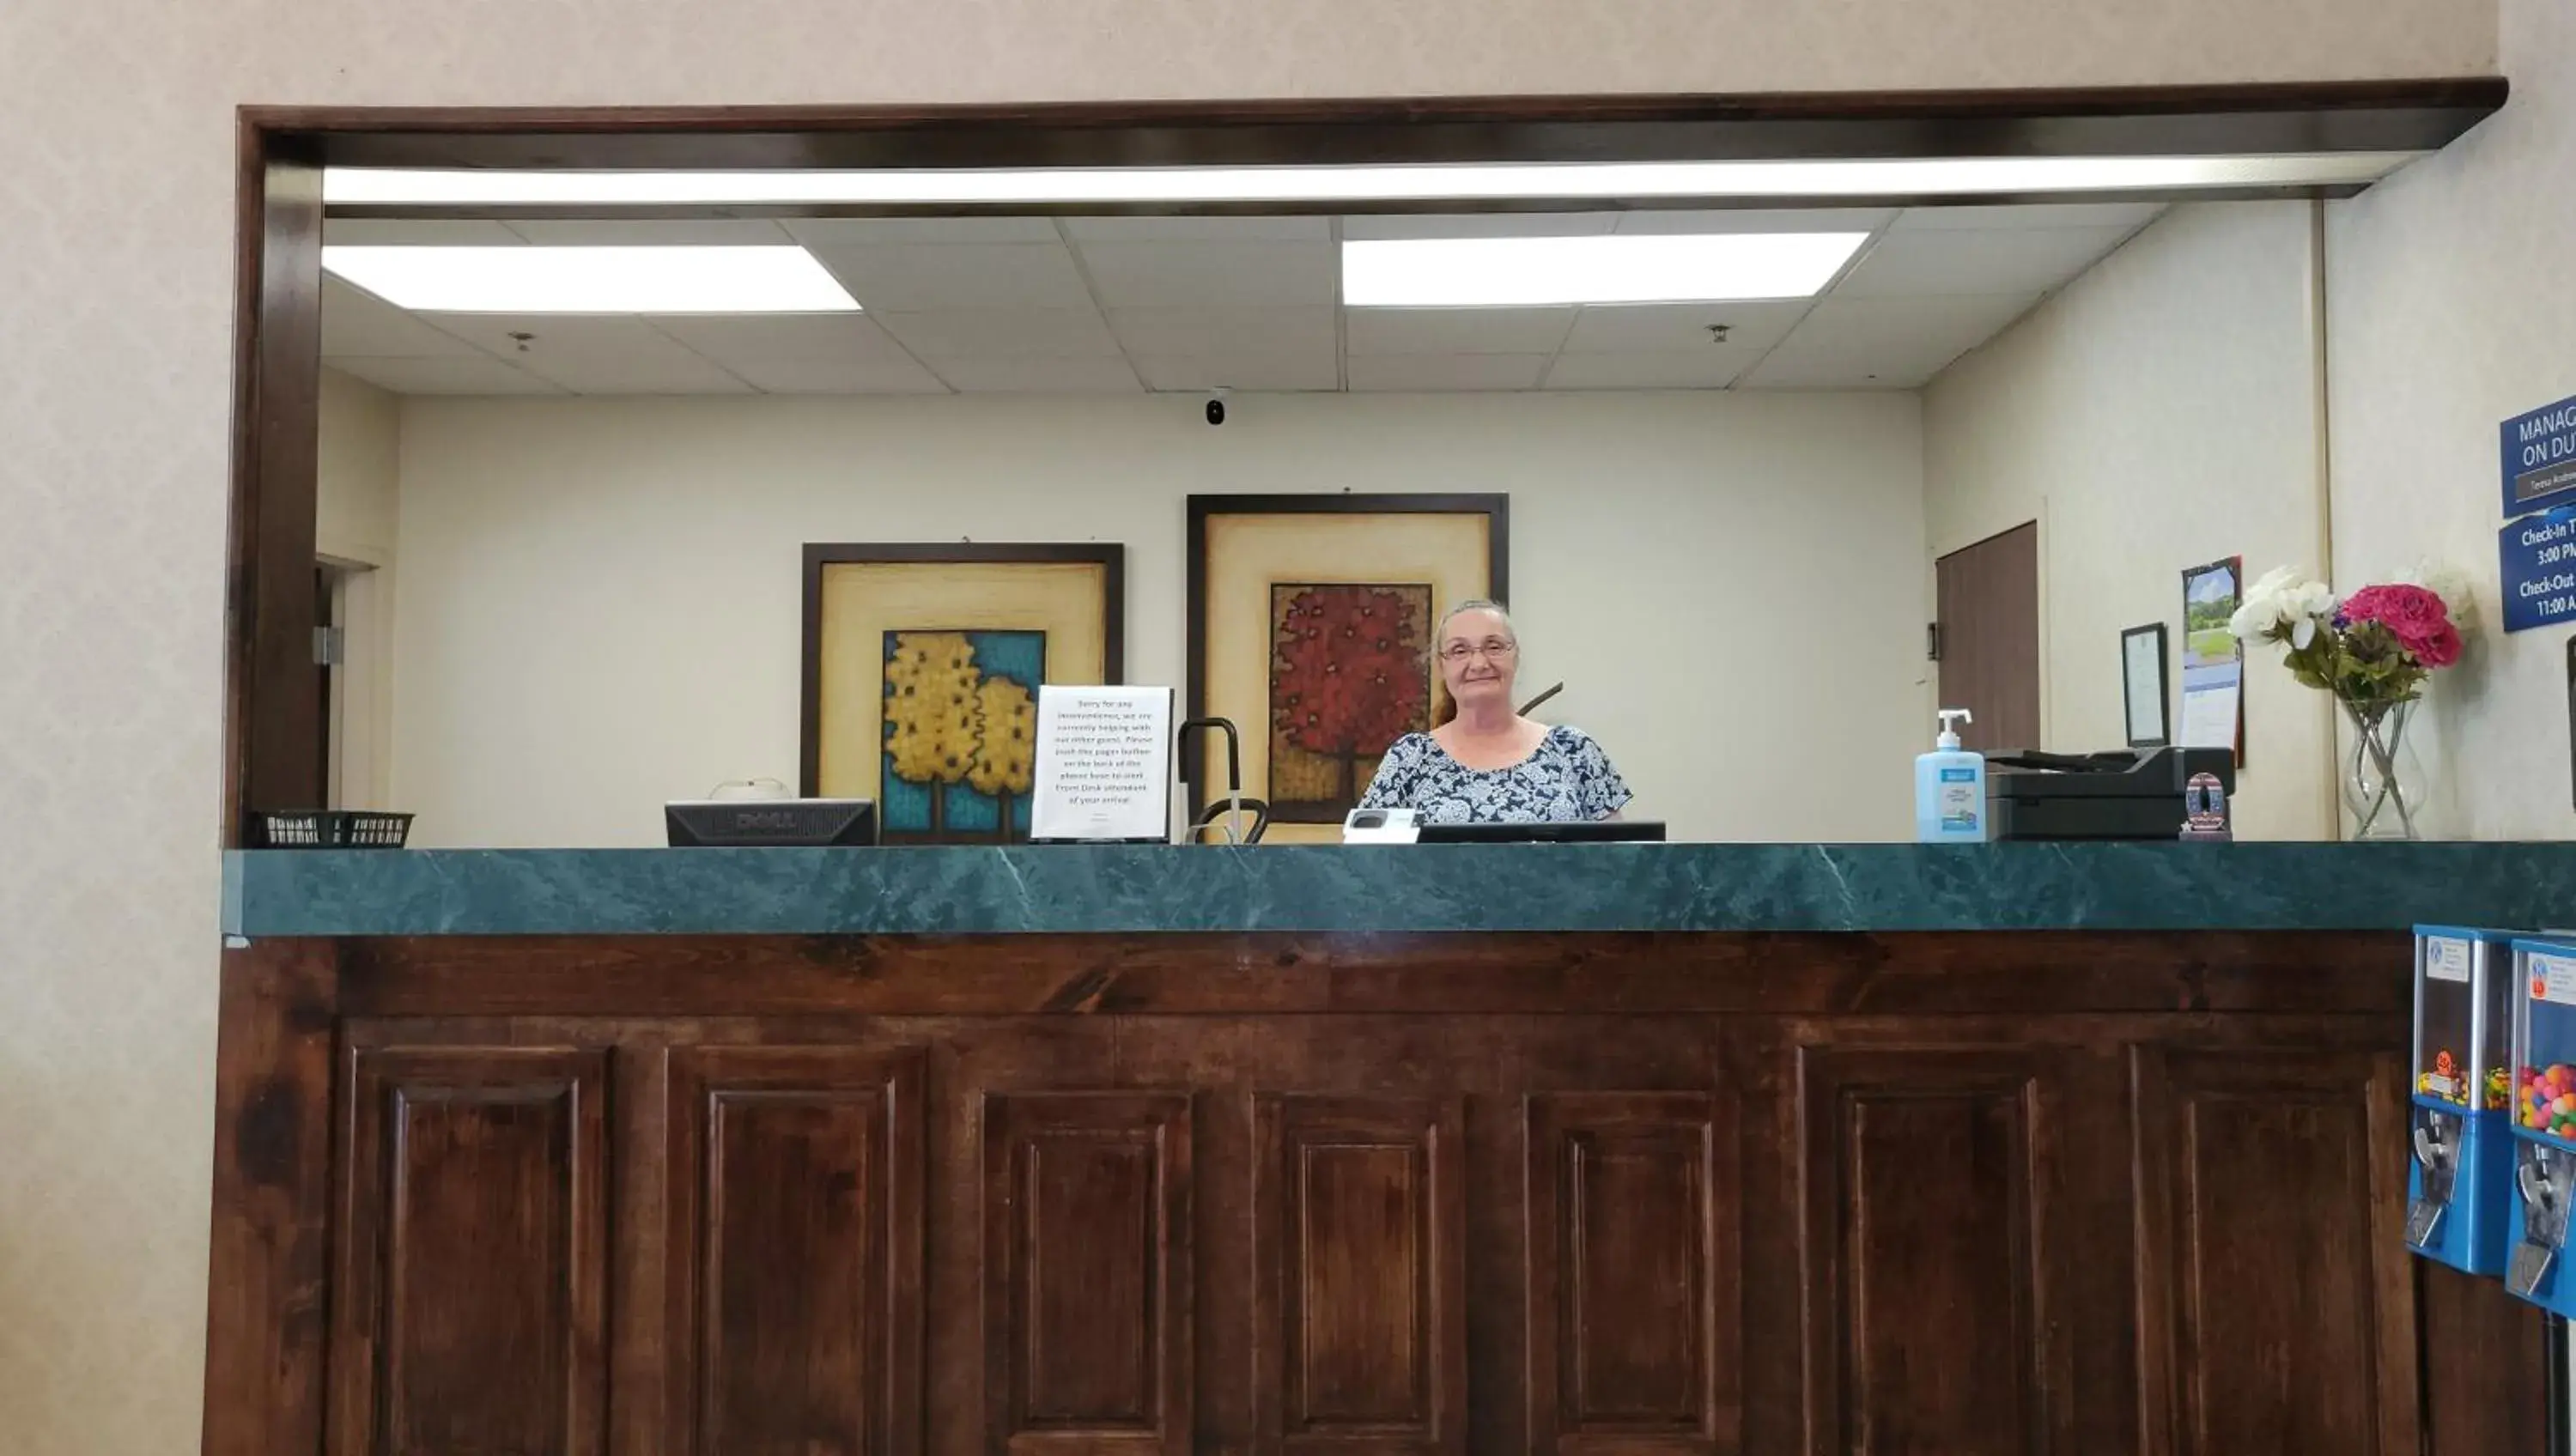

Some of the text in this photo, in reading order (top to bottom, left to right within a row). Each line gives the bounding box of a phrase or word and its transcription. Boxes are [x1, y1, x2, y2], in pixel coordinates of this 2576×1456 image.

[2523, 429, 2576, 466] ON DU
[2522, 524, 2567, 545] Check-In
[2537, 545, 2560, 566] 3:00
[2519, 573, 2574, 597] Check-Out
[2537, 597, 2566, 617] 11:00
[1078, 700, 1100, 708] Sorry
[1069, 796, 1079, 805] of
[738, 811, 797, 829] DELL
